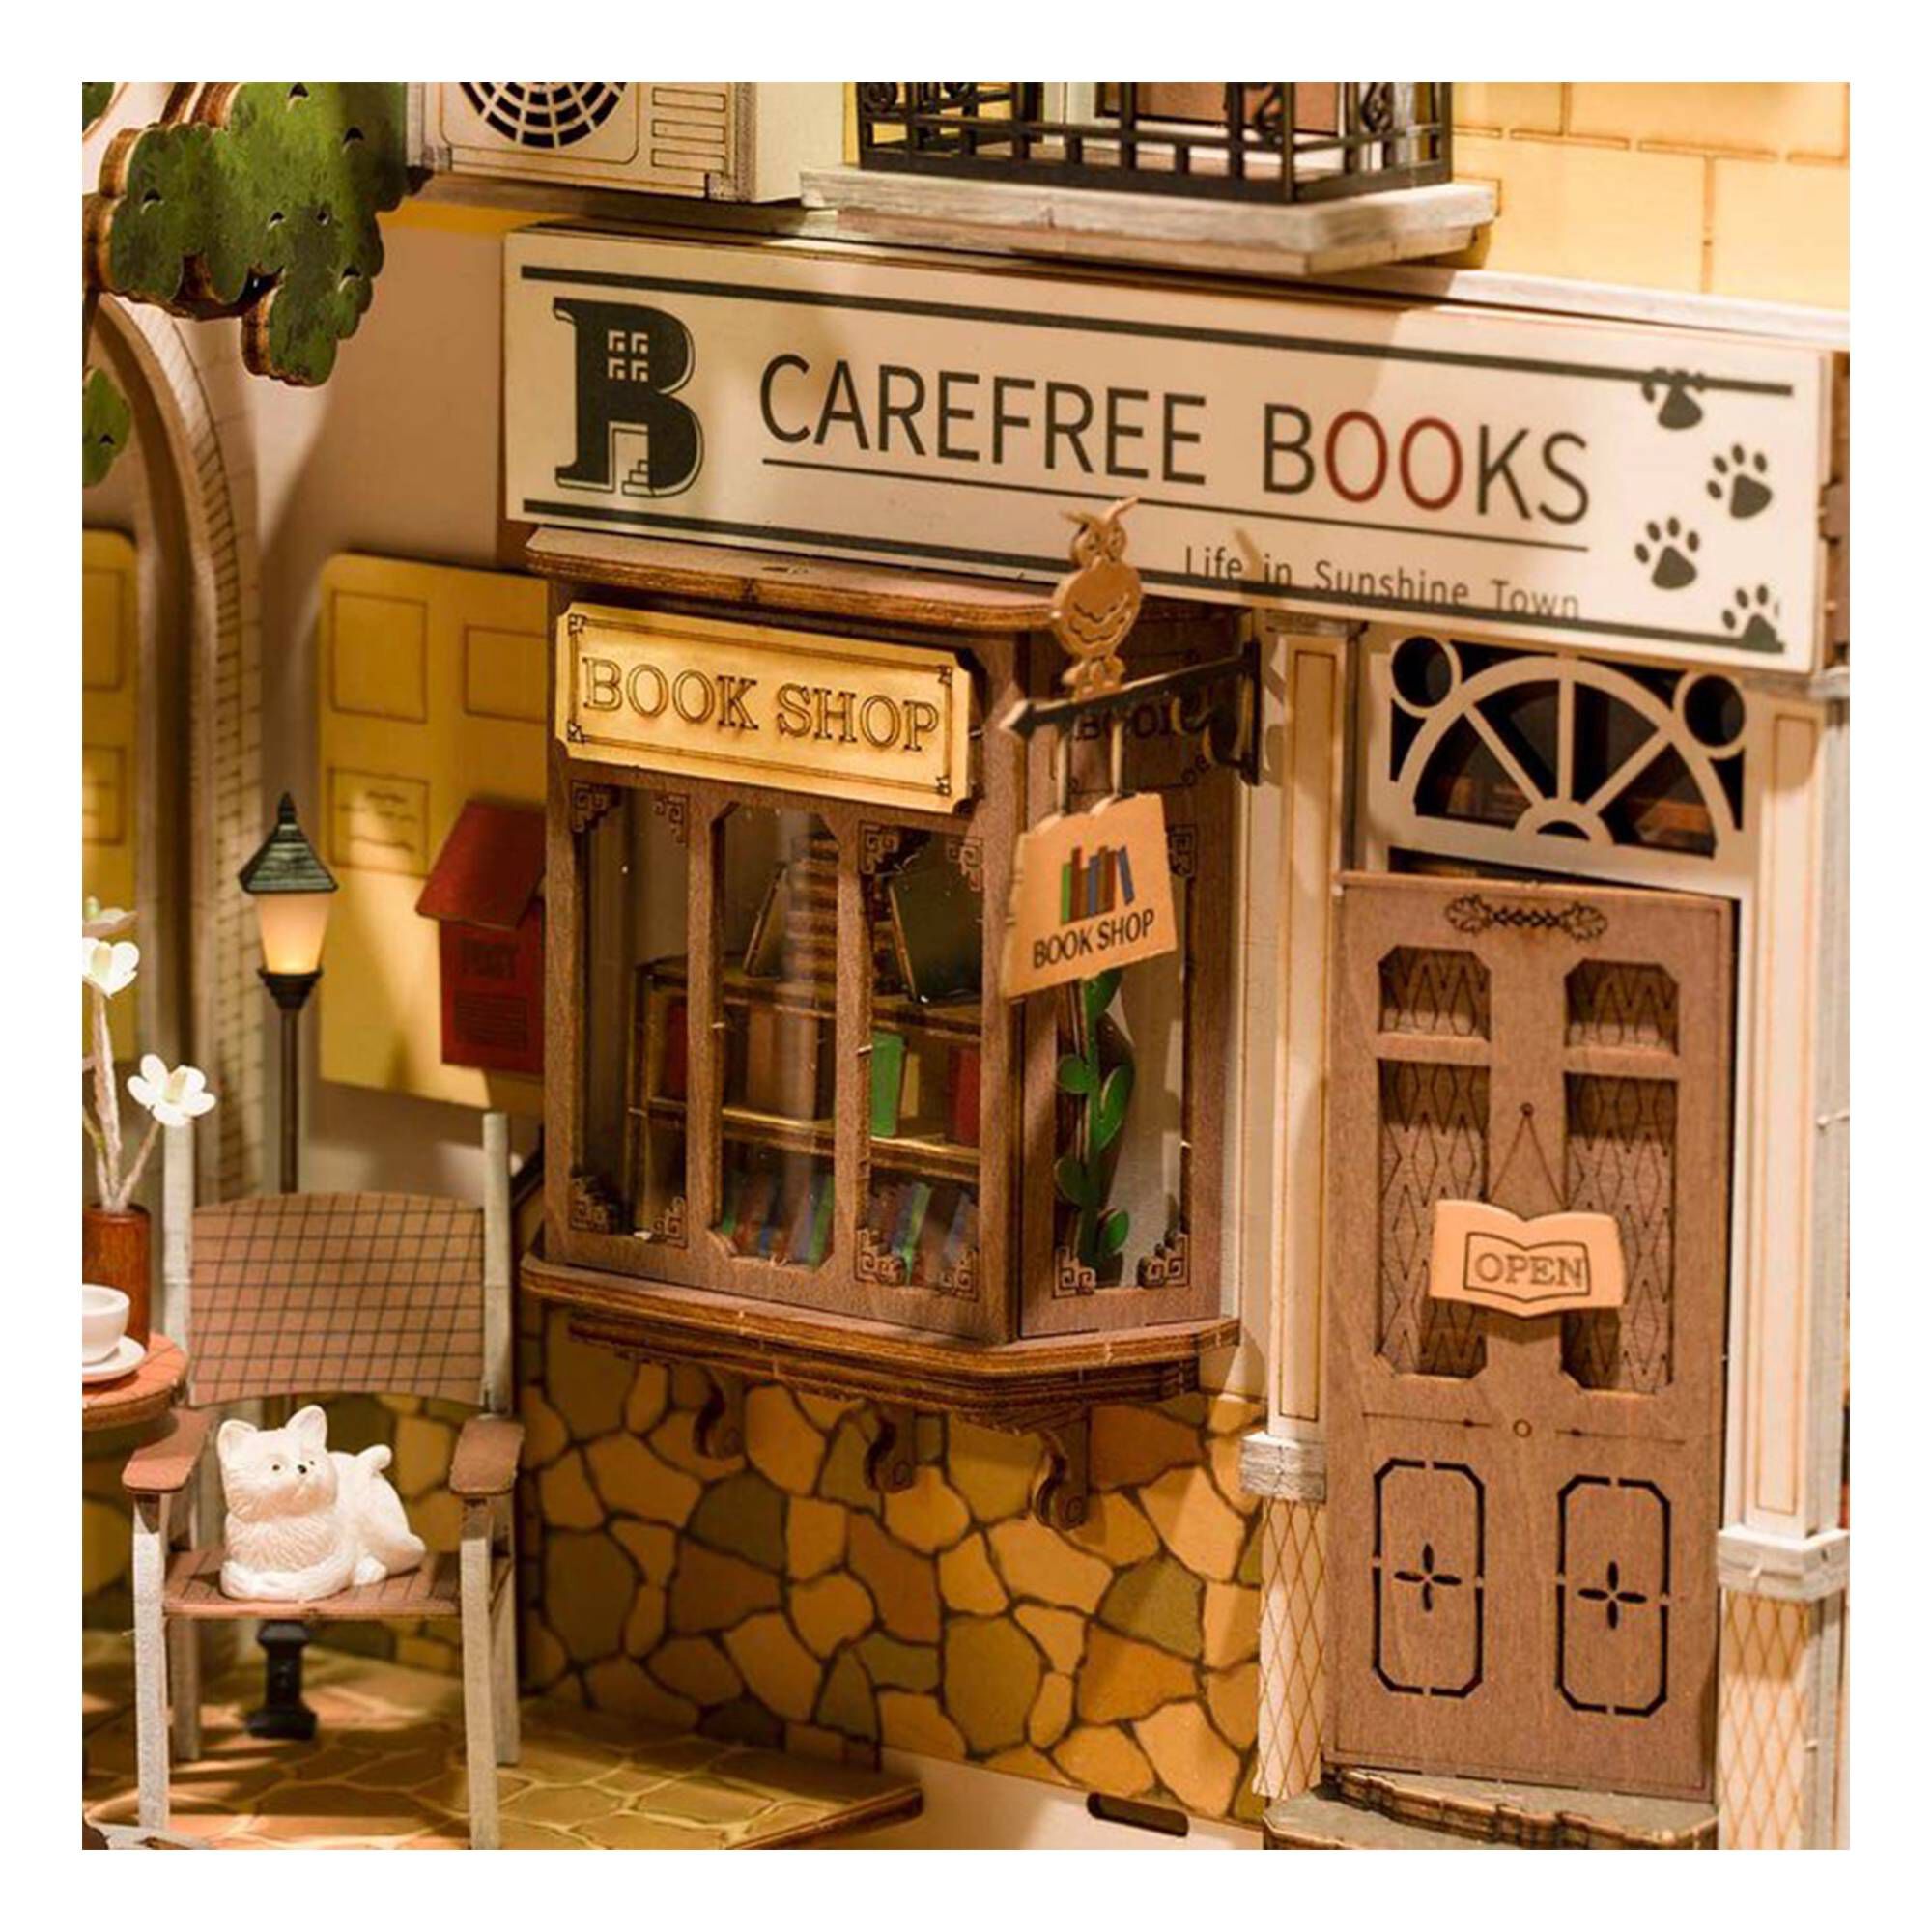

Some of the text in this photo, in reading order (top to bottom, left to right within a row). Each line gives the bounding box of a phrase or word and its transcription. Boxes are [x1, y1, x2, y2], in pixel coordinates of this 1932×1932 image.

[554, 297, 704, 498] B
[760, 353, 1590, 526] CAREFREE BOOKS
[1185, 545, 1580, 620] Life in Sunshine Town
[582, 656, 940, 753] BOOK SHOP
[1032, 907, 1155, 969] BOOK SHOP
[1473, 1252, 1584, 1288] OPEN
